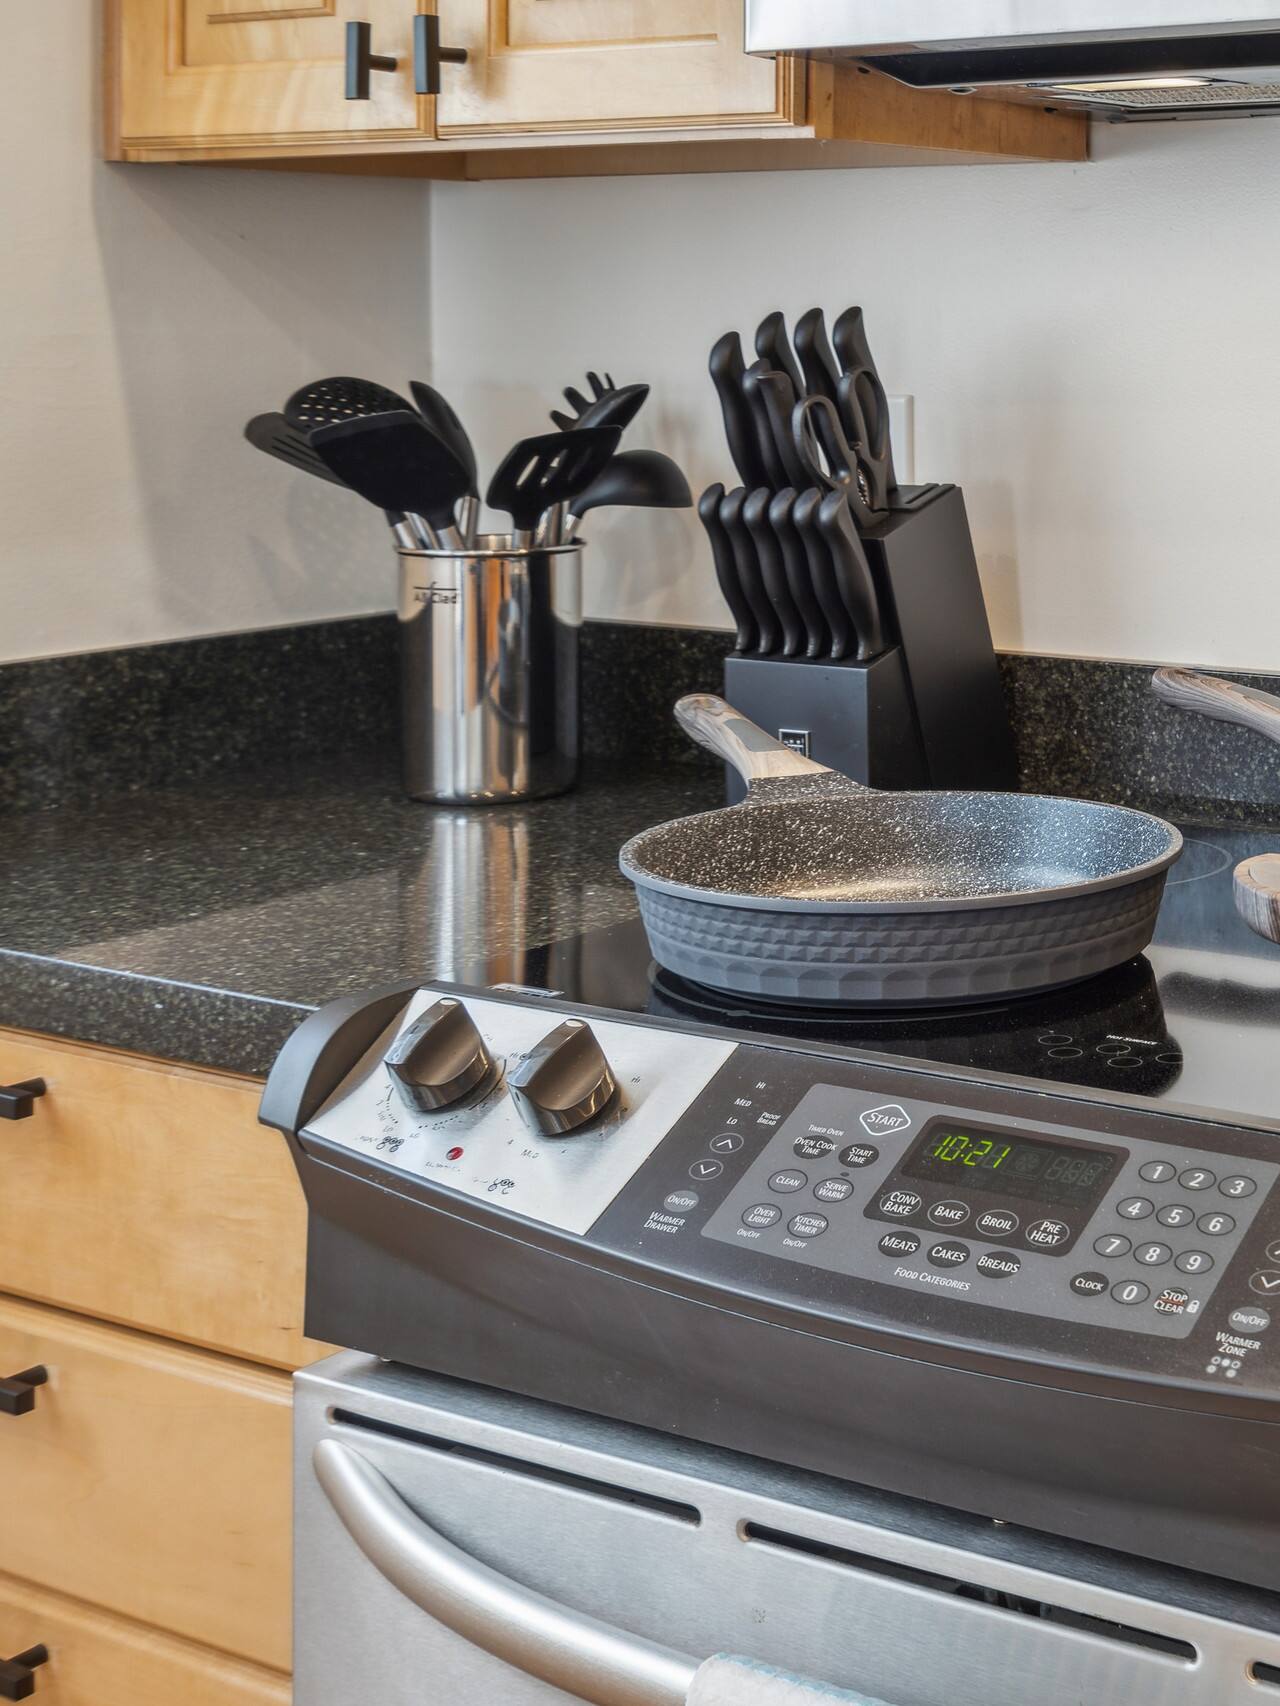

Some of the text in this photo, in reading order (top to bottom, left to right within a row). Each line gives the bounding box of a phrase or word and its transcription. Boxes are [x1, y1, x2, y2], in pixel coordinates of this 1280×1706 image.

[734, 1098, 752, 1107] MED
[867, 1112, 904, 1127] START
[826, 1128, 845, 1137] OVEN
[794, 1136, 839, 1151] OVEN COOK
[801, 1146, 822, 1156] TIME
[849, 1146, 874, 1158] START
[934, 1135, 1012, 1169] 10:21
[847, 1154, 867, 1165] TIME
[775, 1175, 800, 1187] CLEAN
[823, 1181, 849, 1193] SERVE
[1153, 1165, 1246, 1195] 1 2 3
[818, 1187, 845, 1199] WARM
[889, 1191, 920, 1206] CONV
[753, 1207, 776, 1218] OVEN
[883, 1201, 912, 1215] BAKE
[934, 1206, 964, 1220] BAKE
[649, 1211, 686, 1227] WARMER
[747, 1214, 772, 1225] LIGHT
[794, 1215, 827, 1229] KITCHEN
[981, 1215, 1013, 1231] BROIL
[1127, 1202, 1224, 1232] 4 5 6
[643, 1219, 679, 1234] DRAWER
[793, 1222, 818, 1235] TIMER
[1040, 1221, 1062, 1234] PRE
[881, 1235, 918, 1252] MEATS
[1030, 1230, 1060, 1245] HEAT
[931, 1246, 966, 1262] CAKES
[1105, 1239, 1202, 1270] 7 8 9
[977, 1256, 1021, 1274] BREADS
[894, 1267, 971, 1291] FOOD CATEGORIES
[1075, 1278, 1104, 1291] CLOCK
[1122, 1285, 1138, 1300] 0
[1160, 1289, 1188, 1303] STOP
[1153, 1300, 1185, 1314] CLEAR
[1215, 1332, 1261, 1350] WARMER
[1219, 1343, 1247, 1357] ZONE
